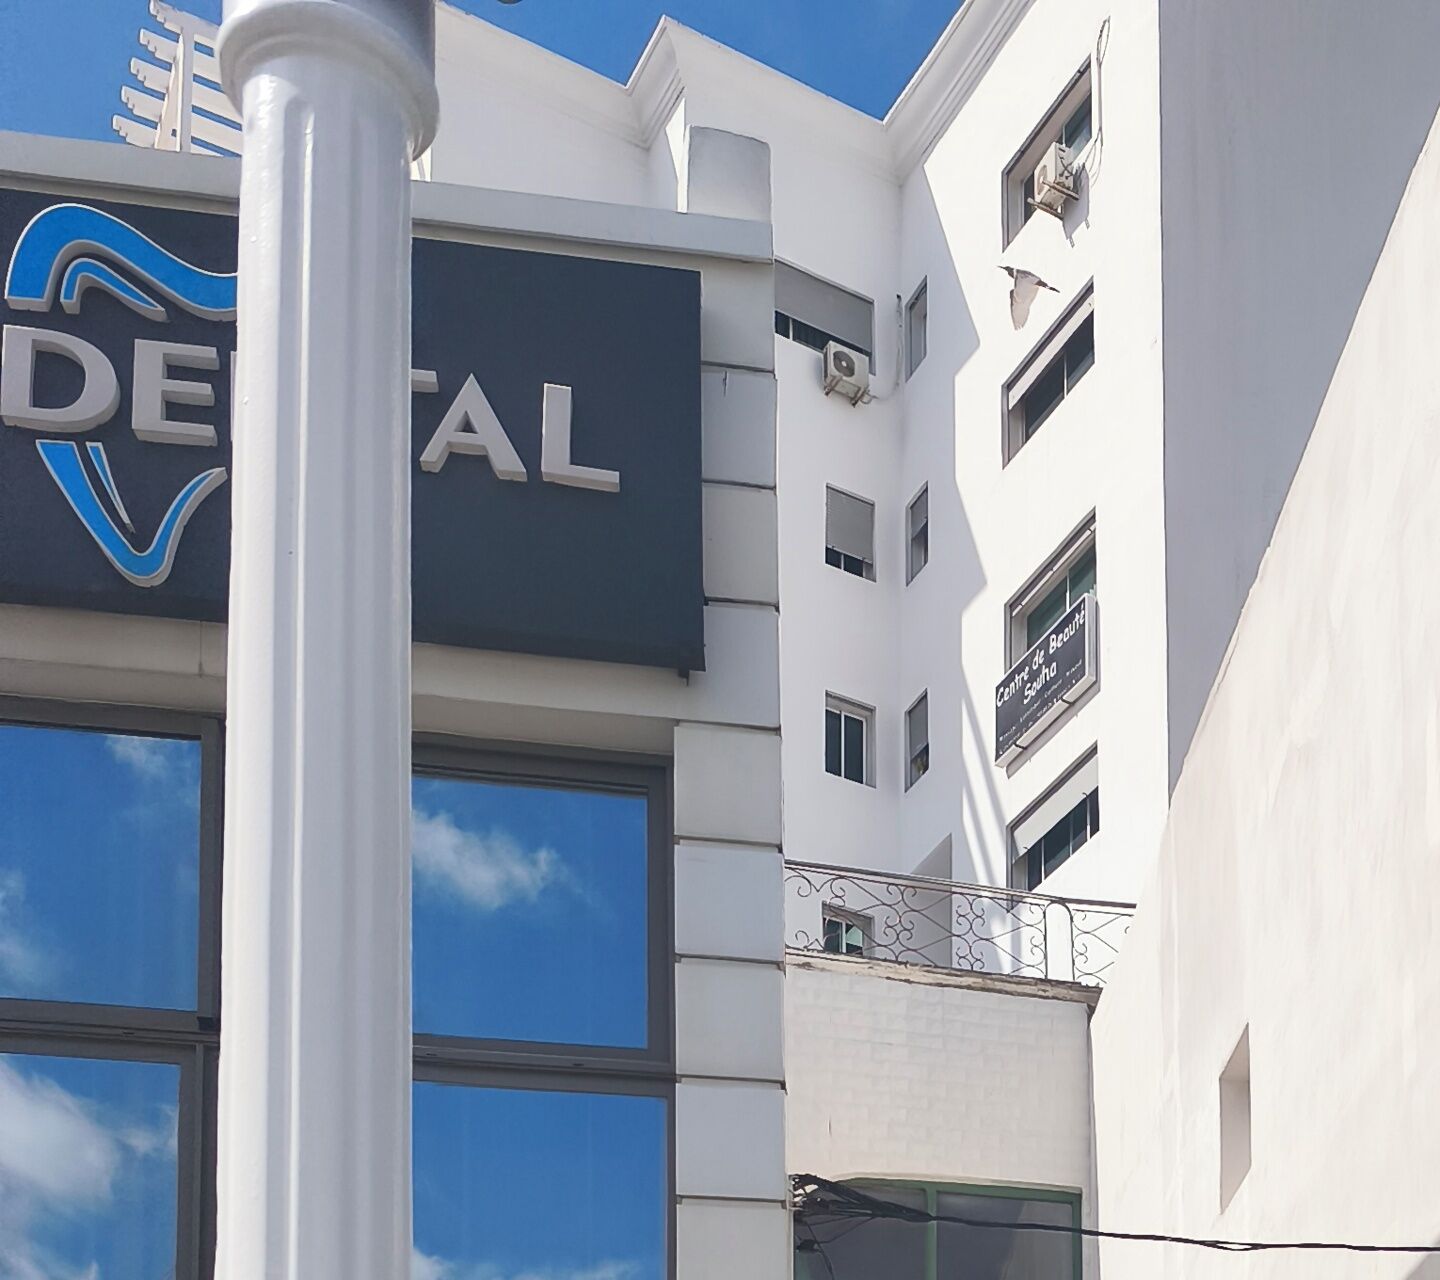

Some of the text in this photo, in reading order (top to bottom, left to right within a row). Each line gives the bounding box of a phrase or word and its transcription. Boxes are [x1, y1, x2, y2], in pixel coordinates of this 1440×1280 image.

[2, 325, 620, 493] DEAL
[996, 666, 1030, 708] Centre
[1032, 648, 1045, 669] de
[1048, 603, 1085, 655] Beauté
